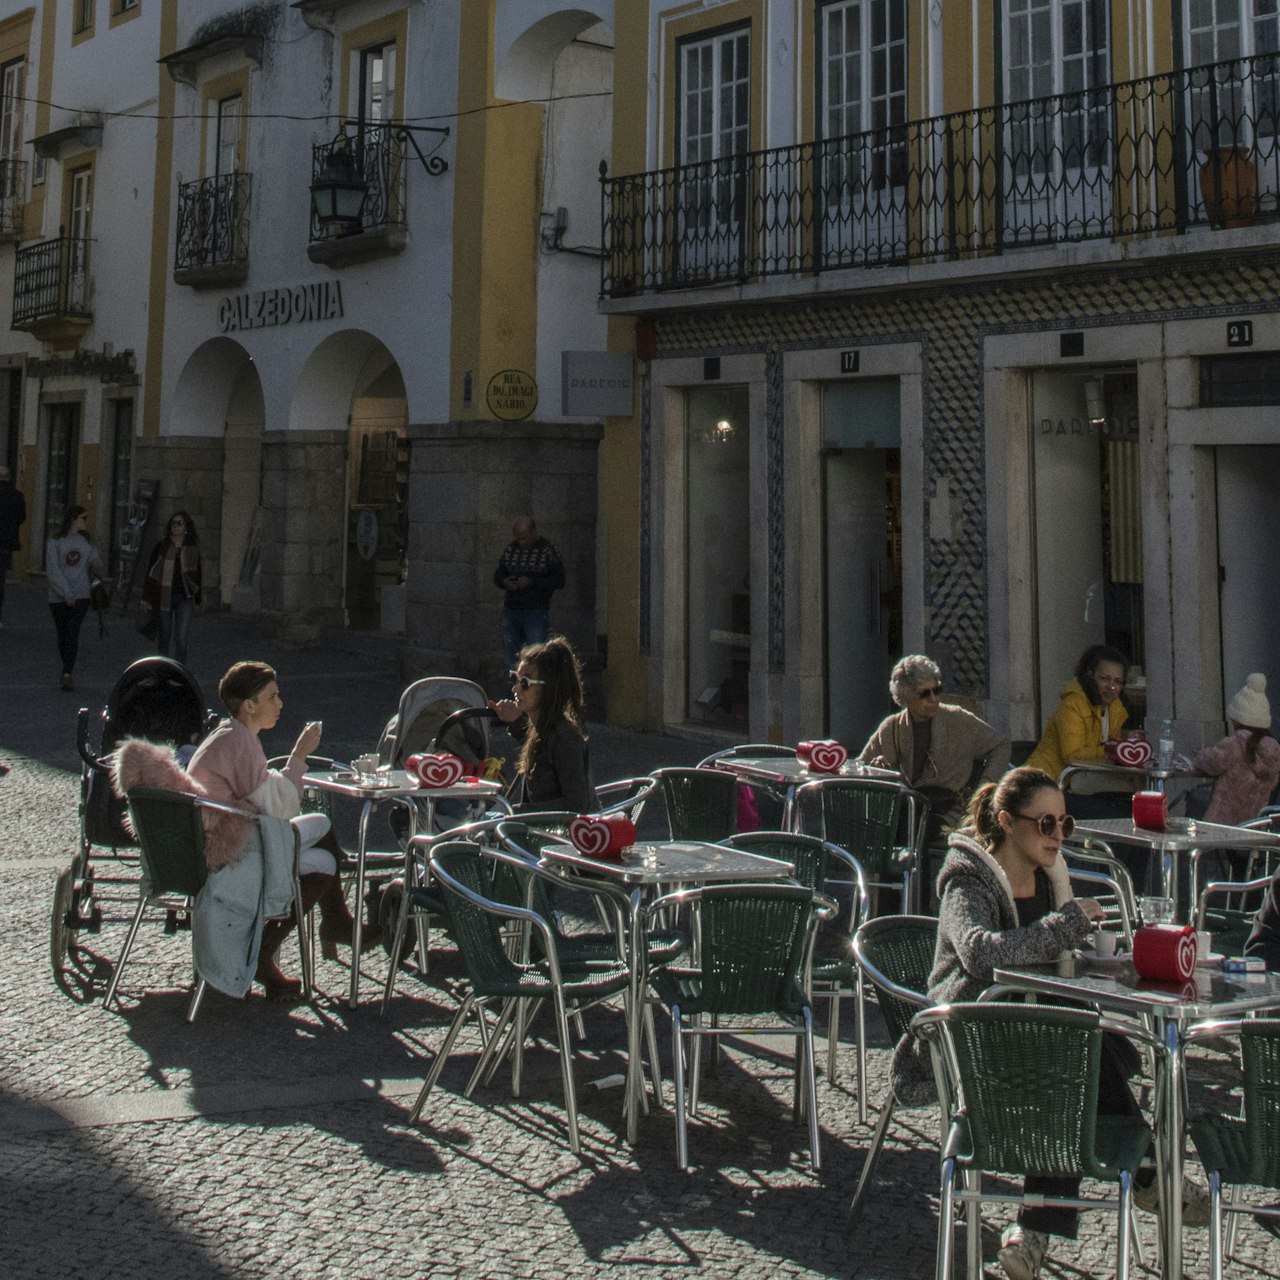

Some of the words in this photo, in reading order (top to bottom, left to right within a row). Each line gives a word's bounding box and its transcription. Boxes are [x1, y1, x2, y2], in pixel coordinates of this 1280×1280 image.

[220, 280, 344, 333] CALZEDONIA
[1230, 324, 1250, 343] 21
[844, 352, 855, 370] 17
[503, 373, 522, 385] RUA
